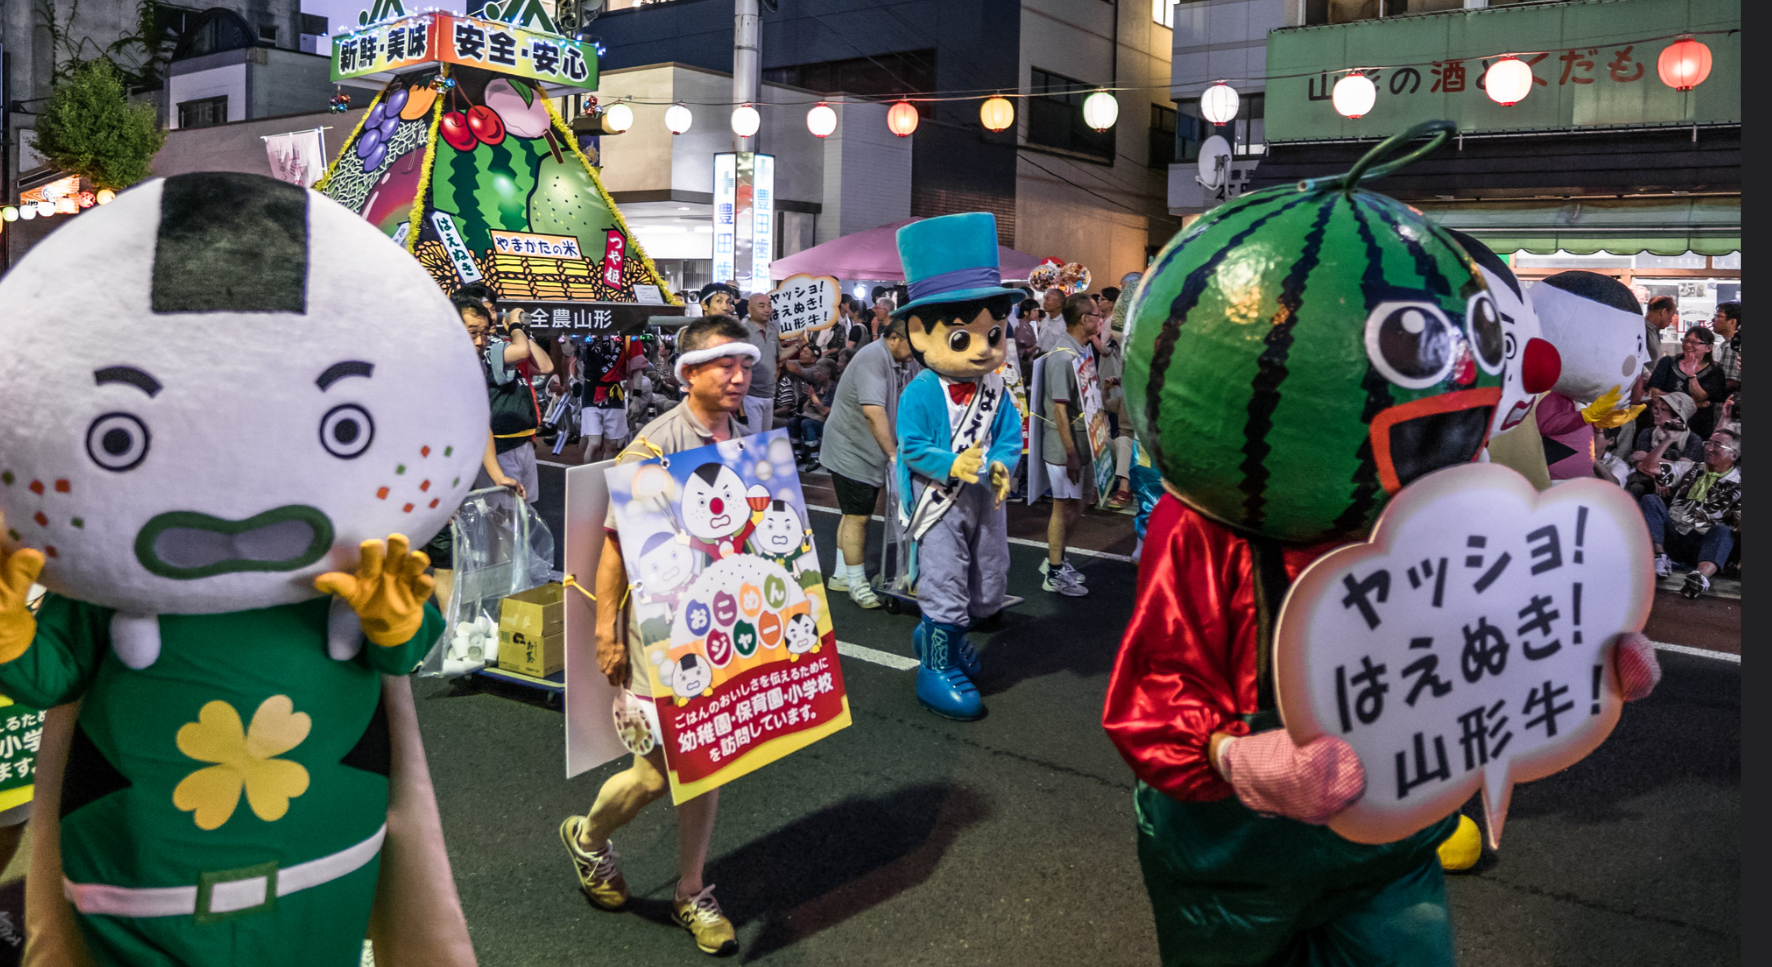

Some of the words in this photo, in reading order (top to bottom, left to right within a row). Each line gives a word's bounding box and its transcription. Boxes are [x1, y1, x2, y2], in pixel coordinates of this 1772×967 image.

[340, 21, 427, 73] 新鮮・美味
[455, 24, 587, 80] 安全・安心
[435, 217, 474, 277] はえぬき
[605, 237, 623, 285] つや姫
[754, 189, 770, 284] 豊田歯科
[530, 308, 612, 329] 全農山形
[770, 280, 824, 304] ヤッショ!
[770, 295, 823, 321] はえぬき!
[780, 311, 828, 333] 山形牛!
[1341, 505, 1590, 631] ヤッショ!
[689, 580, 785, 631] おこめん
[1334, 582, 1584, 735] はえぬき!
[0, 709, 47, 733] るため
[675, 657, 829, 729] ごはんのおいしさを伝えるために
[677, 672, 834, 754] 幼稚園・保育園・小学校
[709, 704, 817, 763] を訪問しています。
[1395, 664, 1604, 801] 山形牛!
